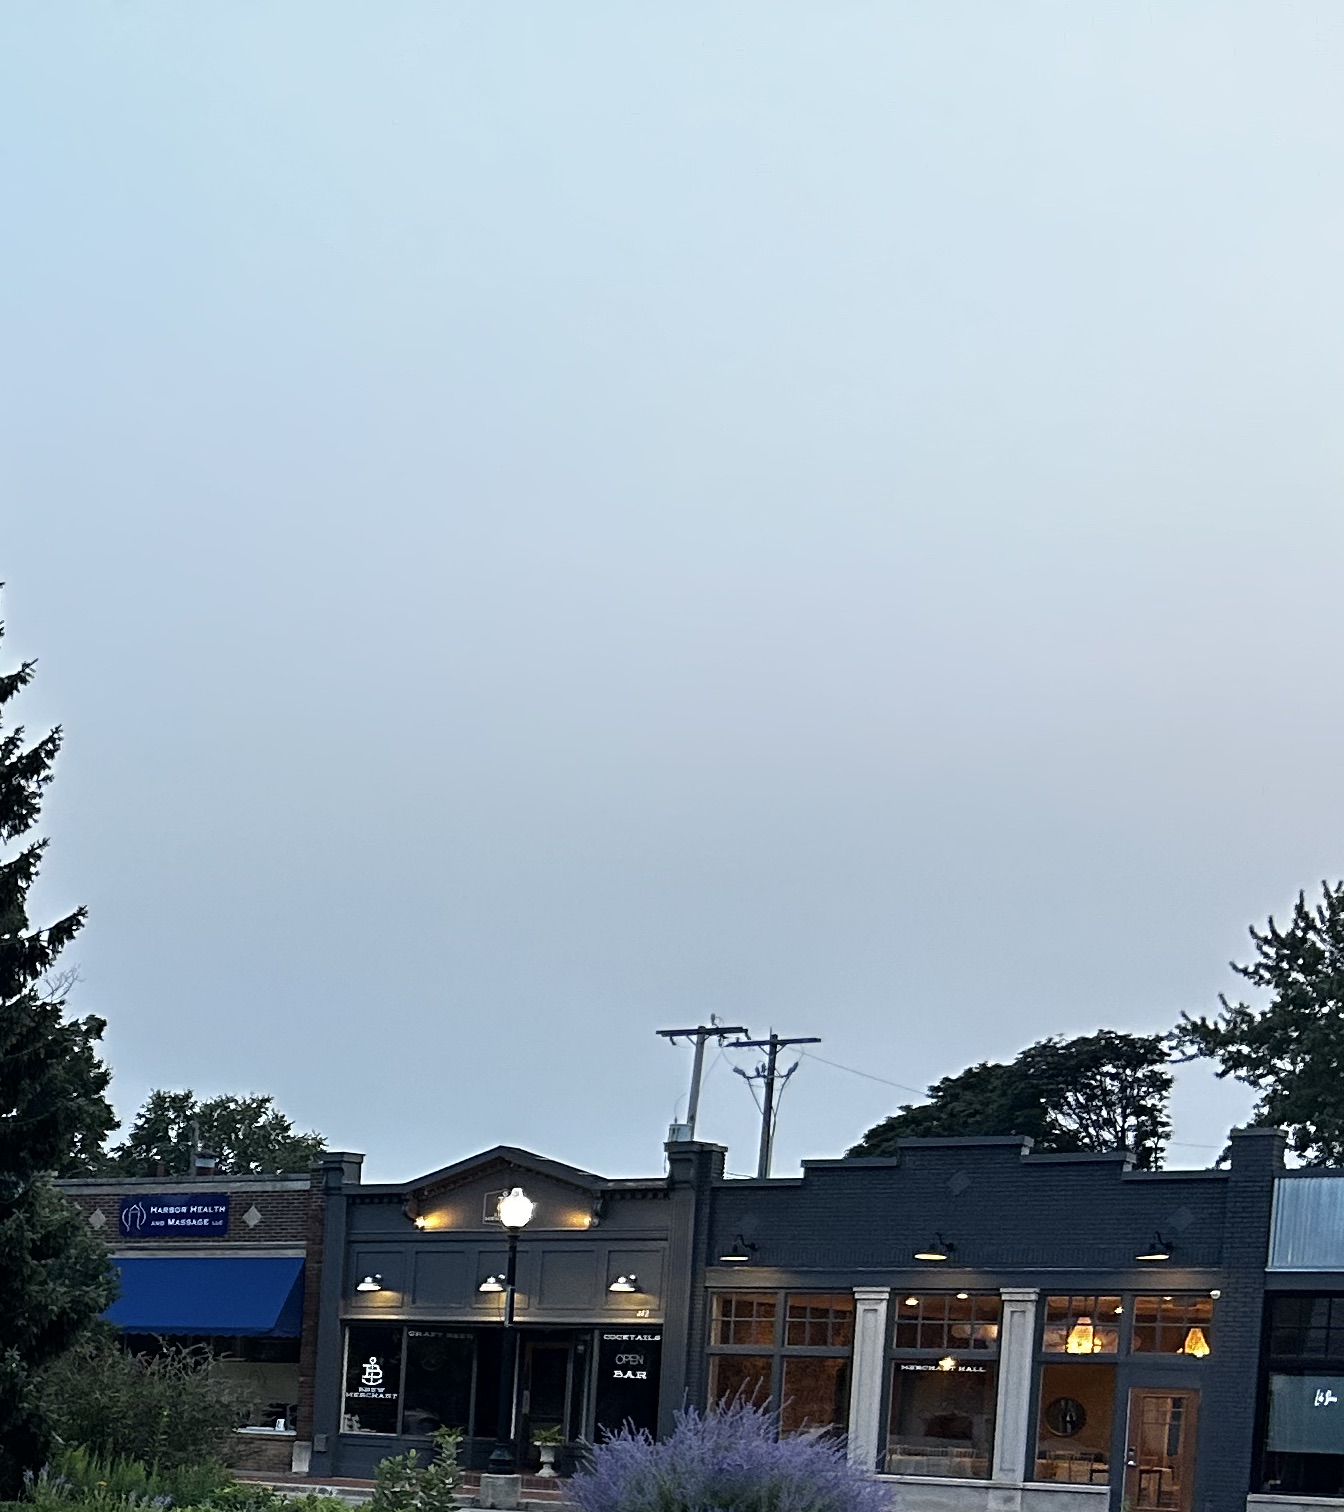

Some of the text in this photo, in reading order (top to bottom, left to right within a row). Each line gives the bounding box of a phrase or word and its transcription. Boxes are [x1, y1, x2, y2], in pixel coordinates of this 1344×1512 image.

[150, 1205, 226, 1214] HARBOR HEALTH
[167, 1218, 210, 1226] MASSAGE
[615, 1354, 644, 1365] OPEN
[900, 1364, 956, 1372] MERCHAT
[613, 1370, 647, 1380] BAR
[345, 1391, 398, 1399] MERCHANT
